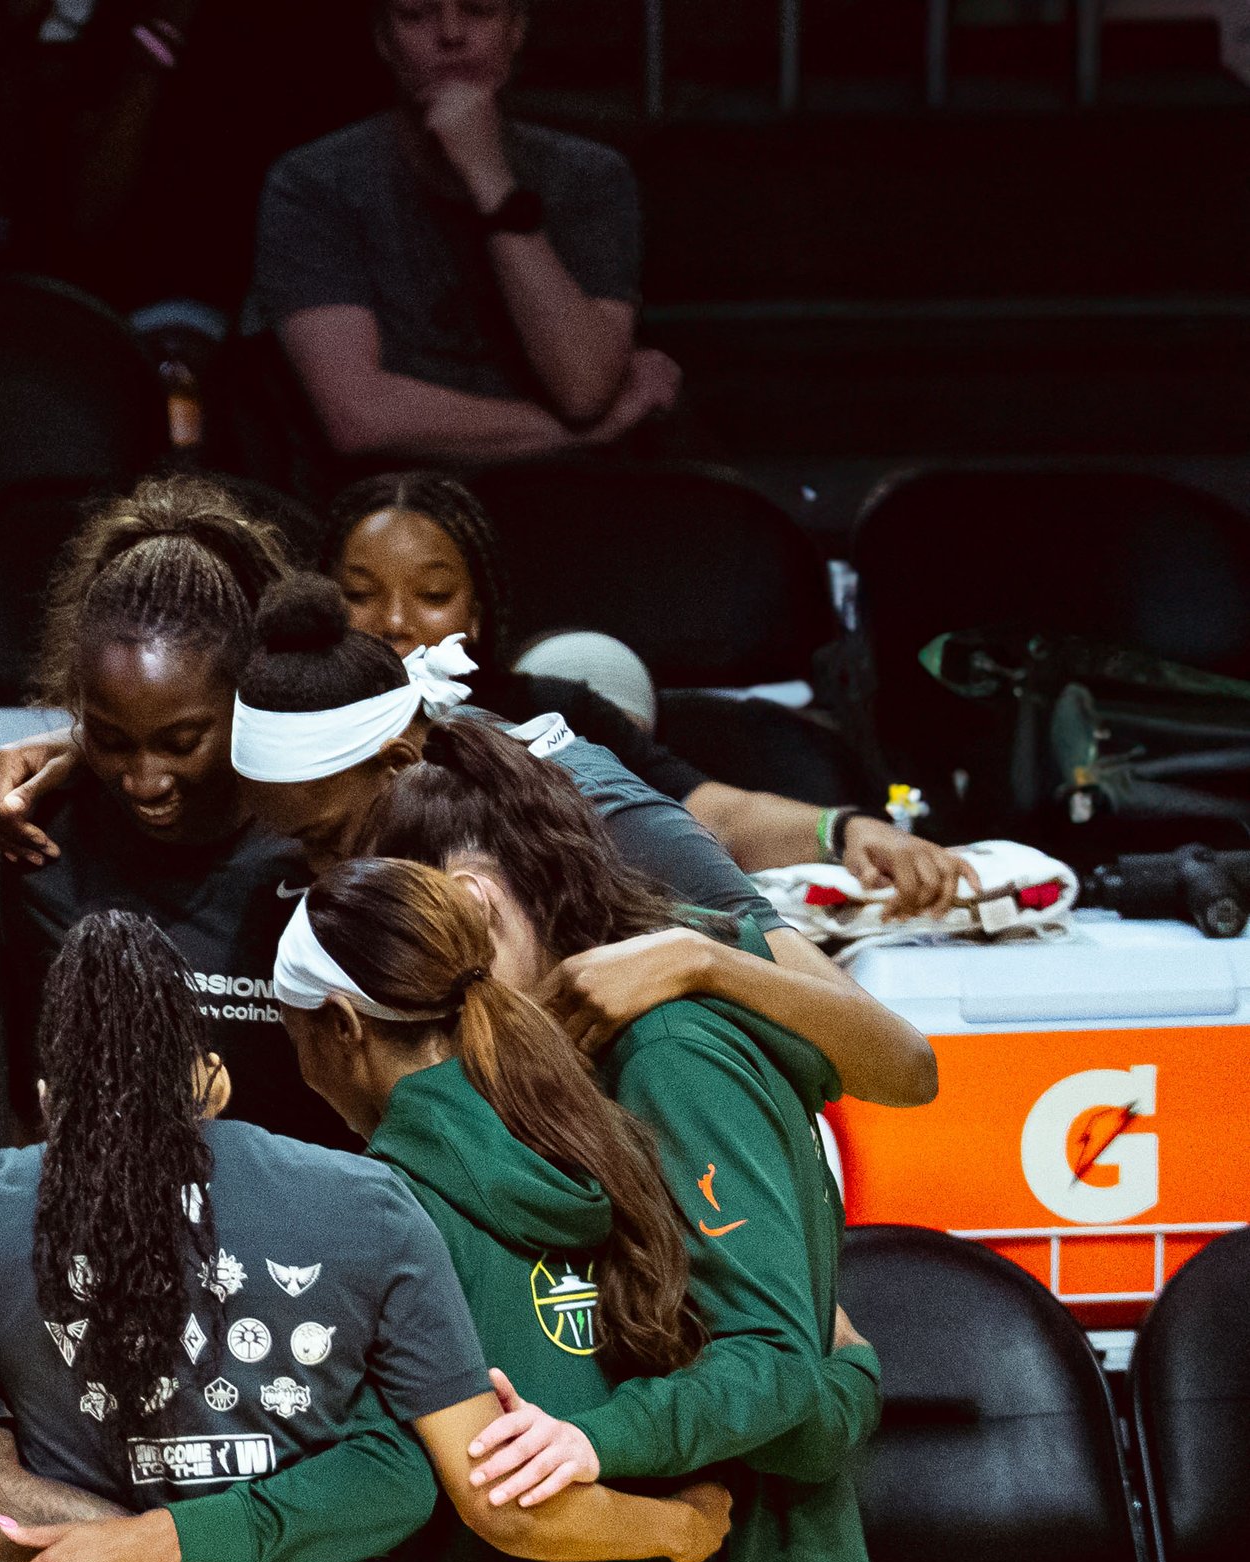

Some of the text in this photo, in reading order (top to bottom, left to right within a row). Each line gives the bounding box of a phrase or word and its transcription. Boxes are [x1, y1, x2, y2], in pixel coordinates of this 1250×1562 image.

[547, 725, 569, 749] NIK
[222, 1003, 284, 1023] coinb
[1020, 1063, 1160, 1224] G
[235, 1440, 268, 1475] W
[170, 1462, 214, 1478] THE
